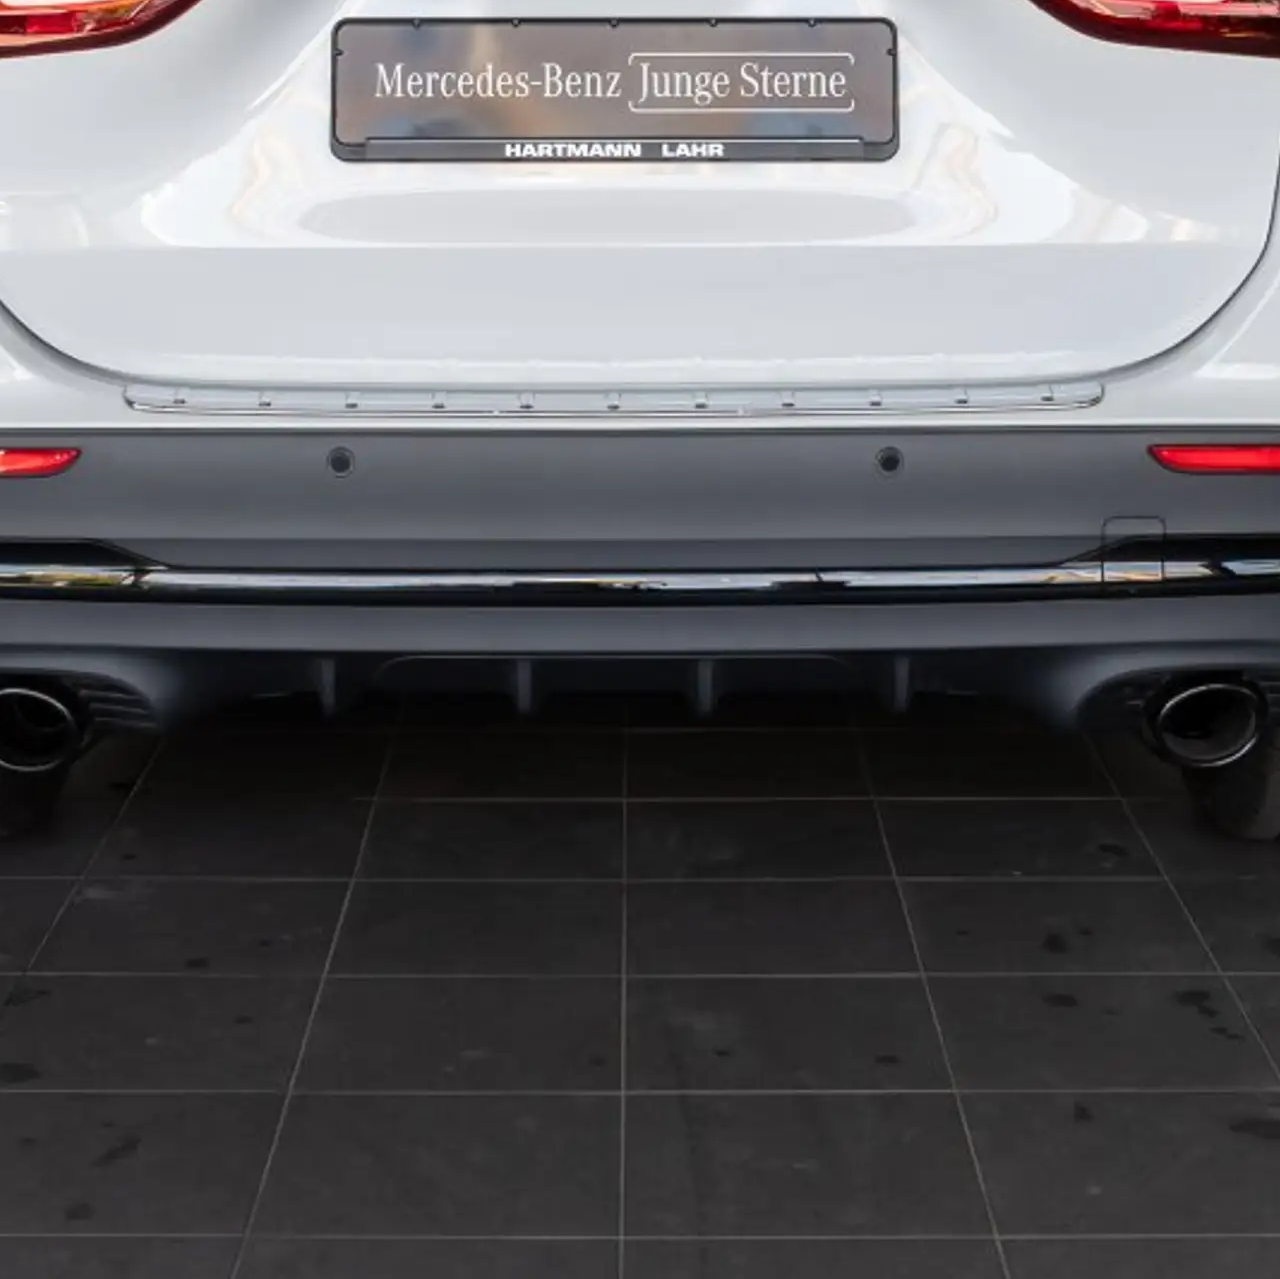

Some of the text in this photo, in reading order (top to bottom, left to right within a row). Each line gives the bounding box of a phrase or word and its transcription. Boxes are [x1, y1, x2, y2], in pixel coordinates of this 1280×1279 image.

[375, 62, 847, 105] Mercedes-Benz Junge Sterne
[505, 143, 725, 158] HARTMANN LAHR
